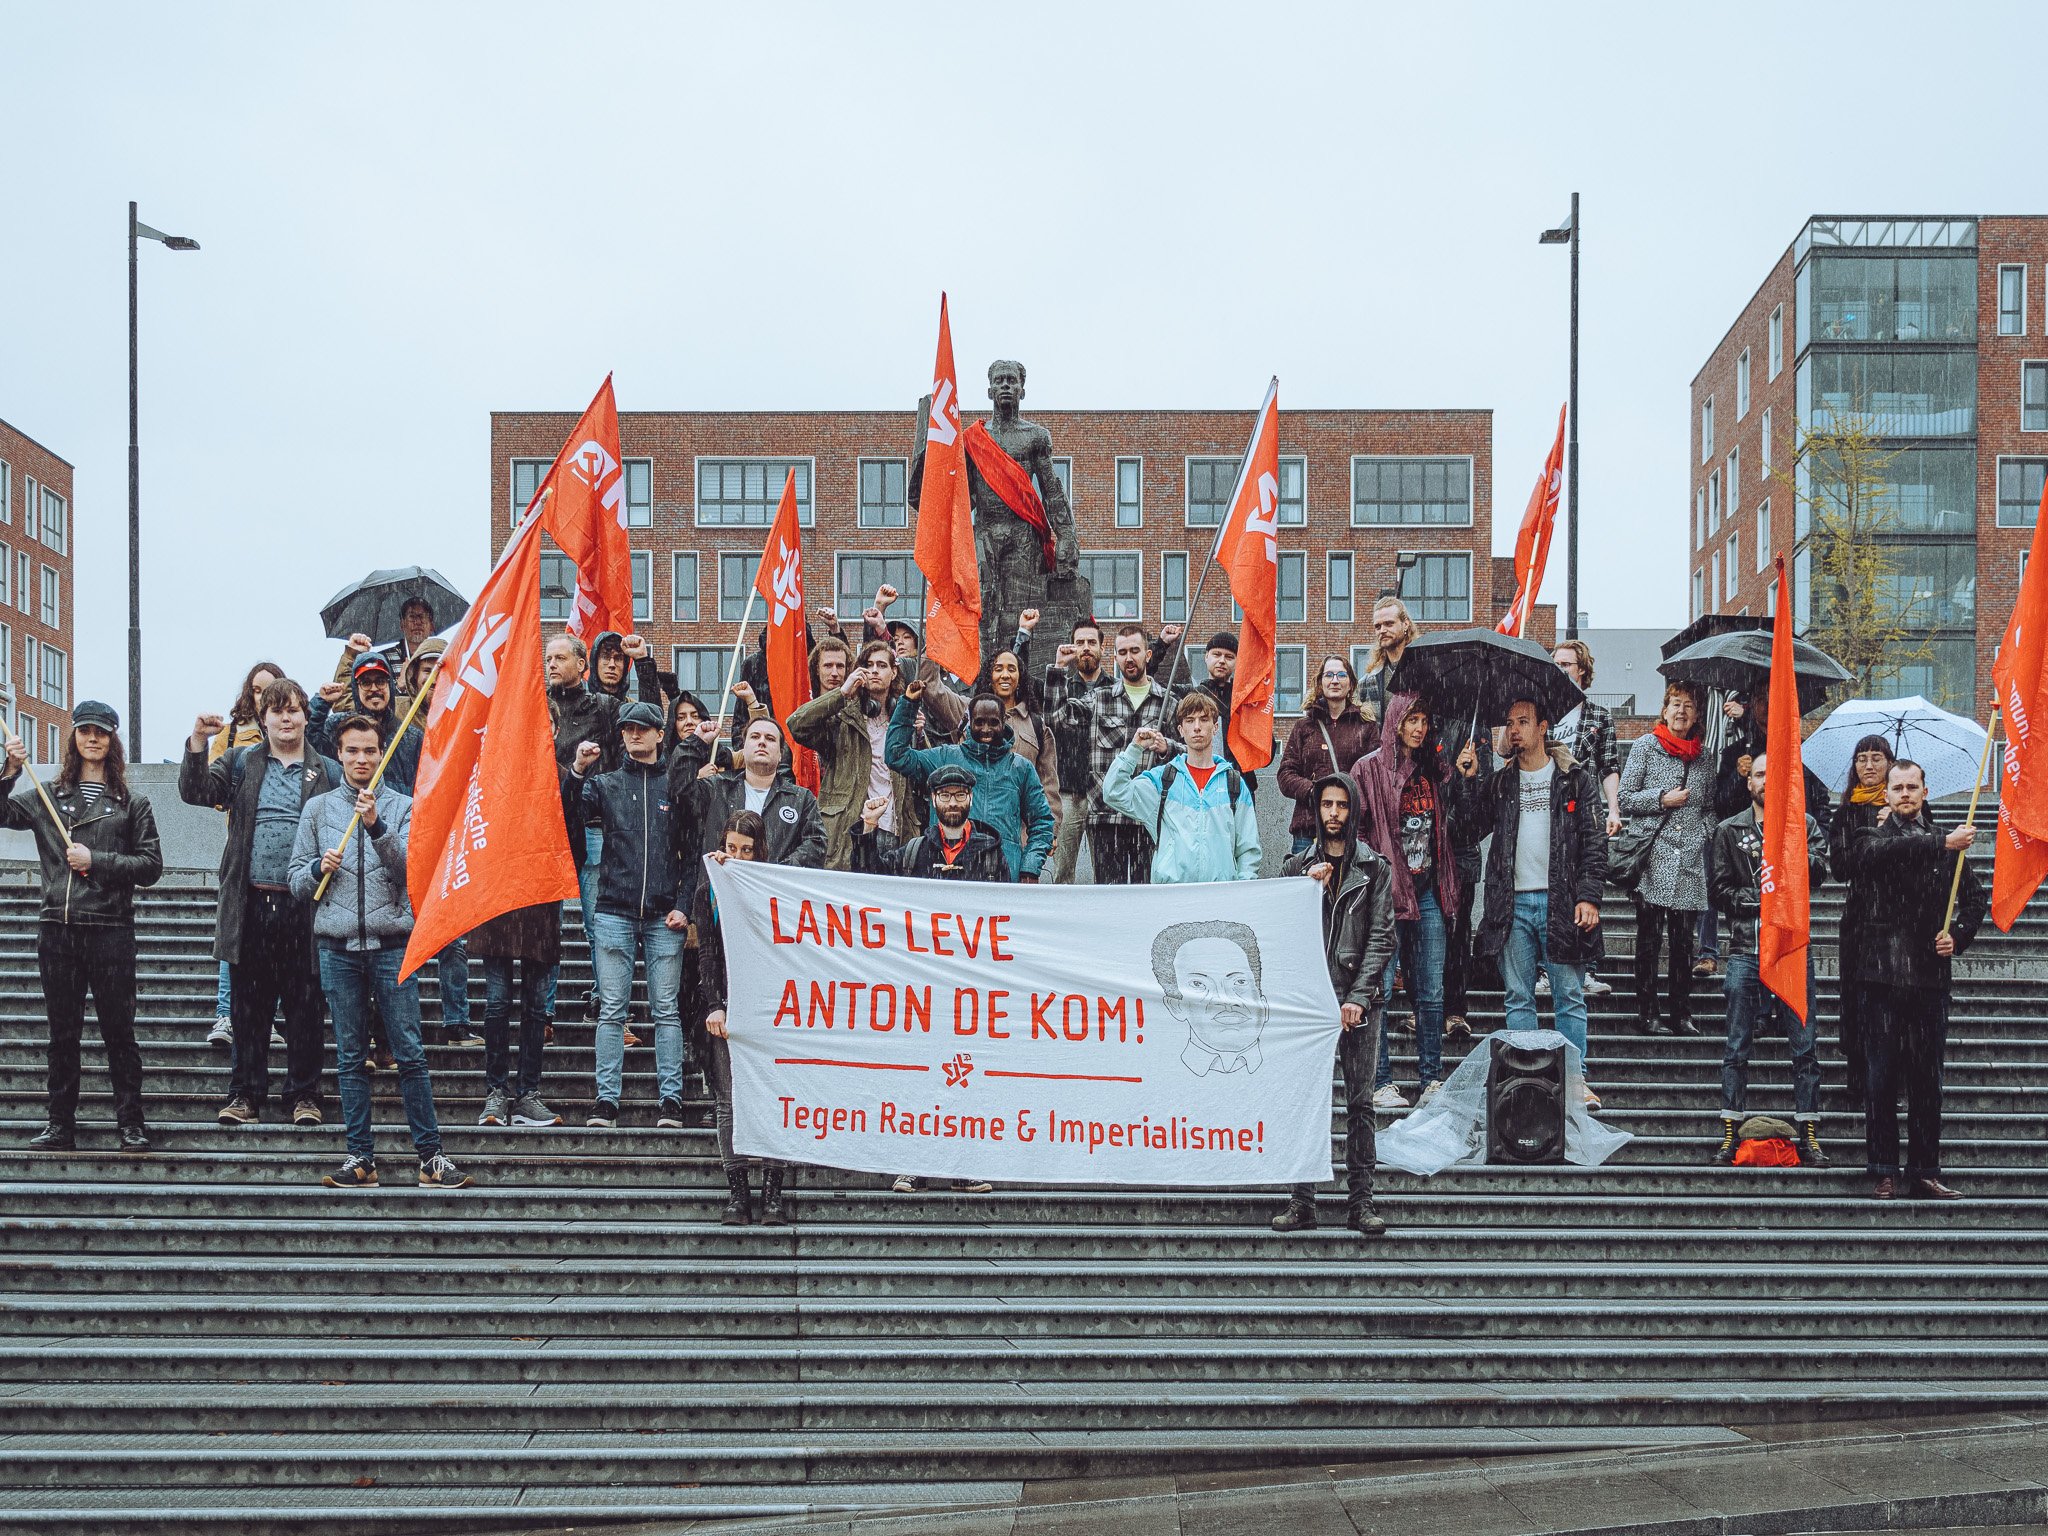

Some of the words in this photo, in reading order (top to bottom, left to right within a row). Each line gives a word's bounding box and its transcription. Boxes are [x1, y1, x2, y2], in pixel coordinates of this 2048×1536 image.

[769, 896, 886, 949] LANG
[905, 911, 1014, 961] LEVE
[773, 979, 932, 1033] ANTON
[953, 987, 1010, 1039] DE
[1031, 992, 1145, 1044] KOM!
[778, 1097, 867, 1140] Tegen
[879, 1102, 1005, 1141] Racisme
[1017, 1109, 1036, 1143] &
[1049, 1110, 1264, 1154] Imperialisme!
